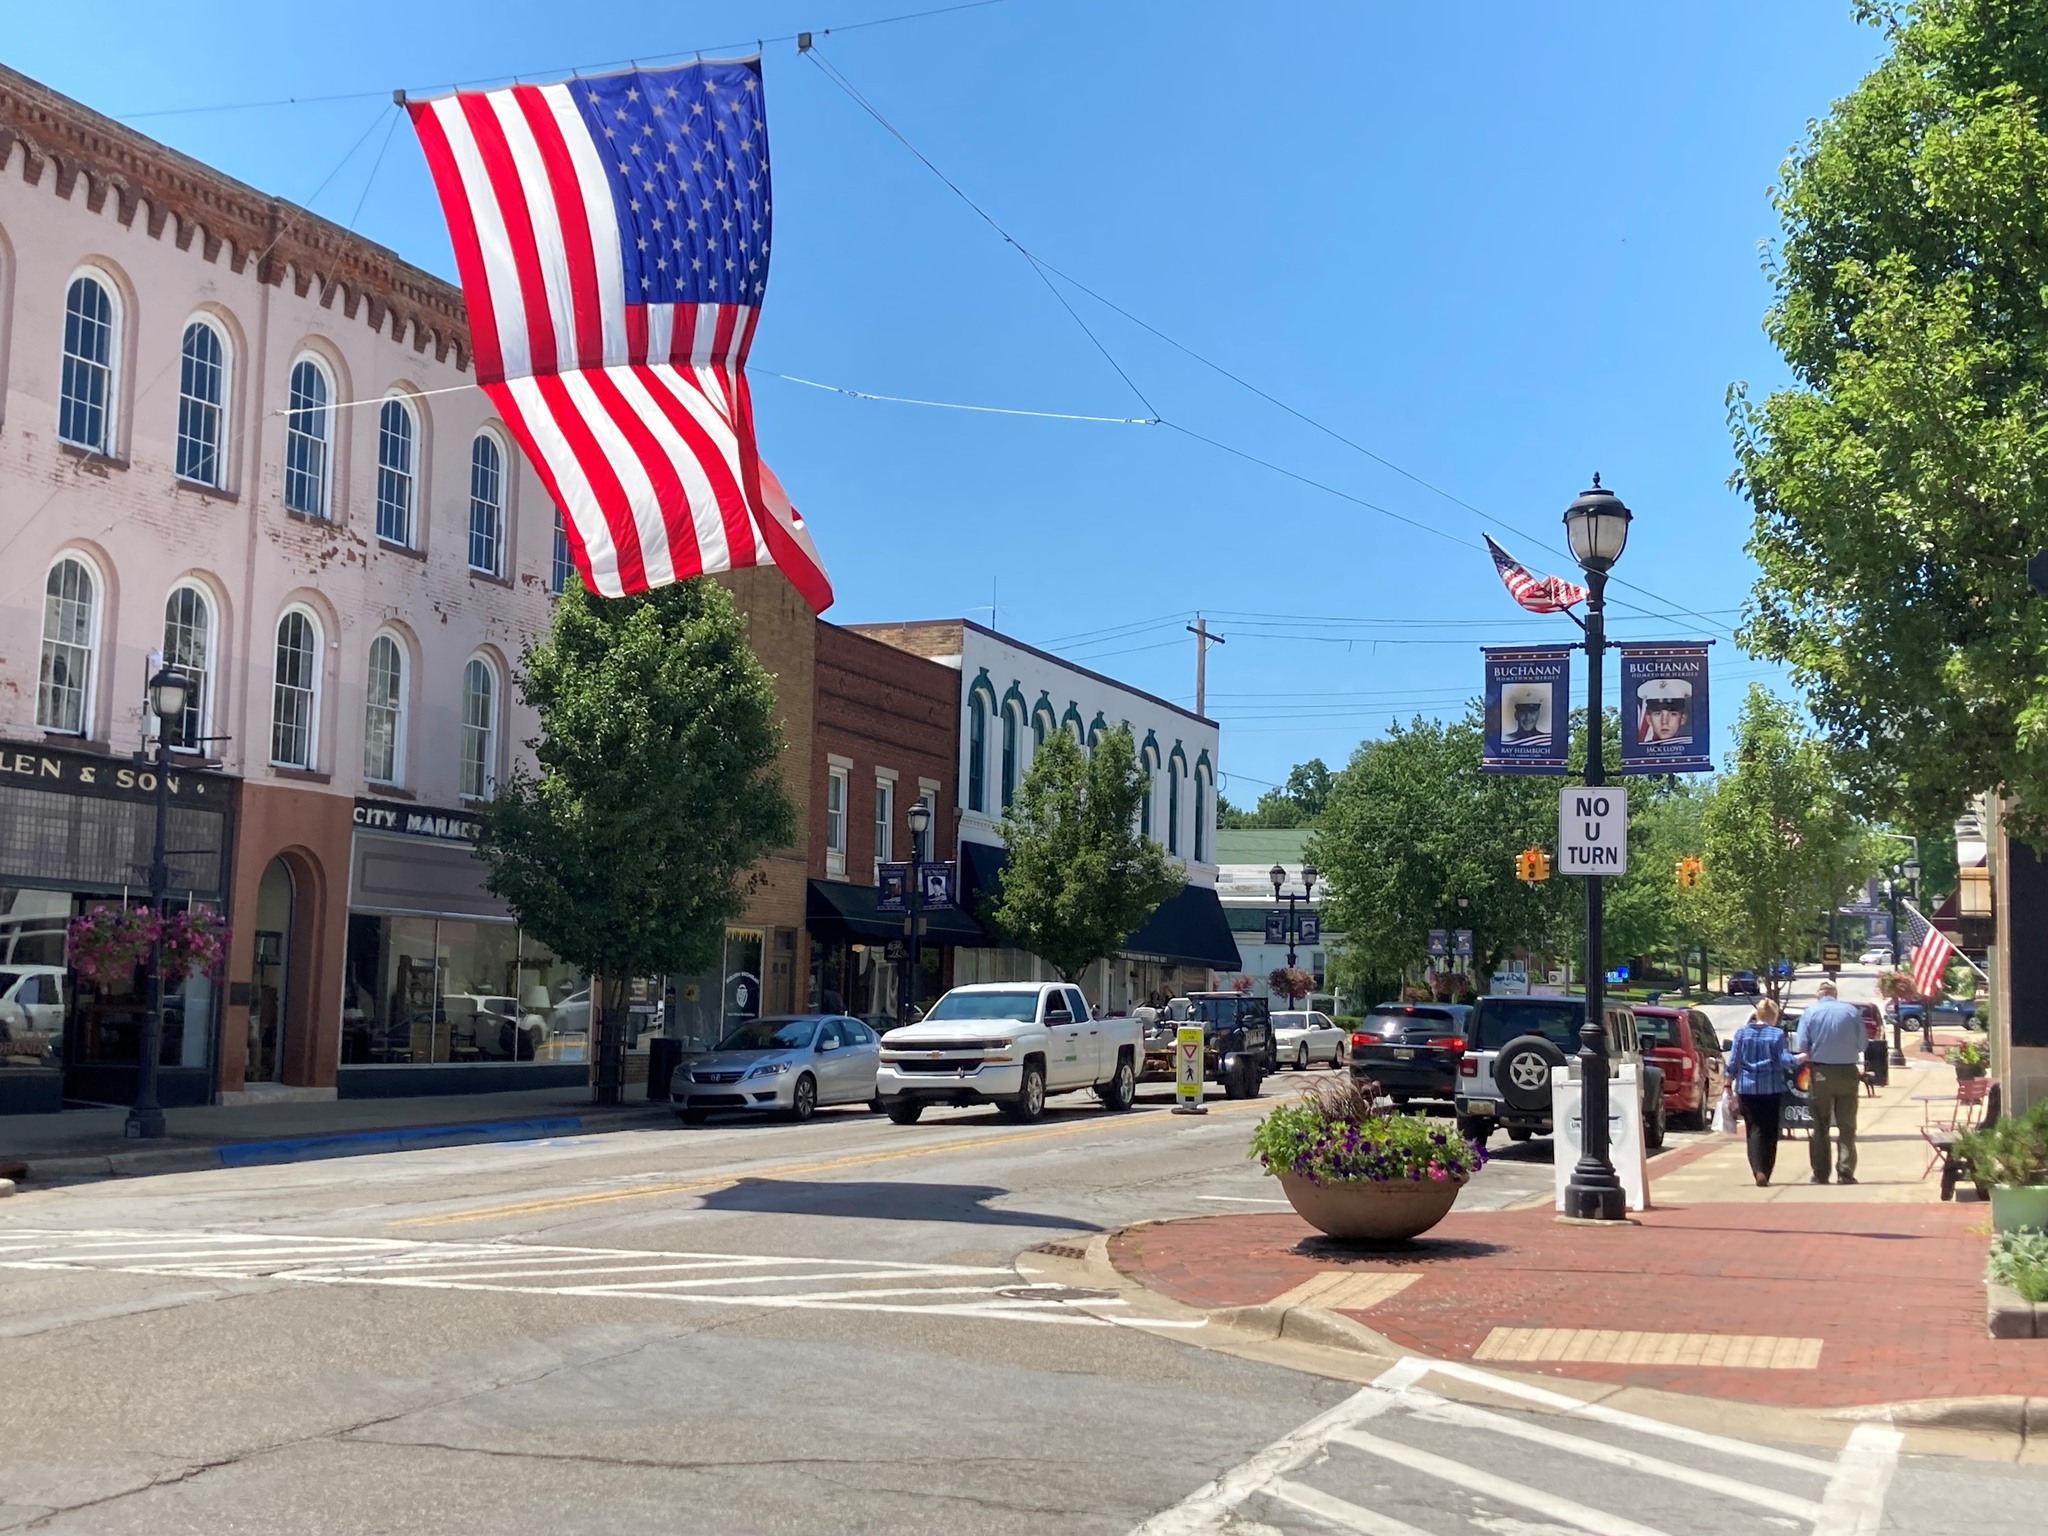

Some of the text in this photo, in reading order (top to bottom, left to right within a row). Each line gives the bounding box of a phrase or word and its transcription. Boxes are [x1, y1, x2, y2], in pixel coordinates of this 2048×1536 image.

[1494, 666, 1561, 677] BUCHANAN
[1629, 662, 1700, 673] BUCHANAN
[1646, 745, 1685, 754] JACK LLOYD
[79, 766, 96, 783] &
[115, 769, 180, 794] SON
[353, 806, 397, 827] CITY
[1576, 797, 1610, 817] NO
[1585, 822, 1600, 841] U
[1567, 846, 1617, 865] TURN
[1785, 1105, 1813, 1121] OPE
